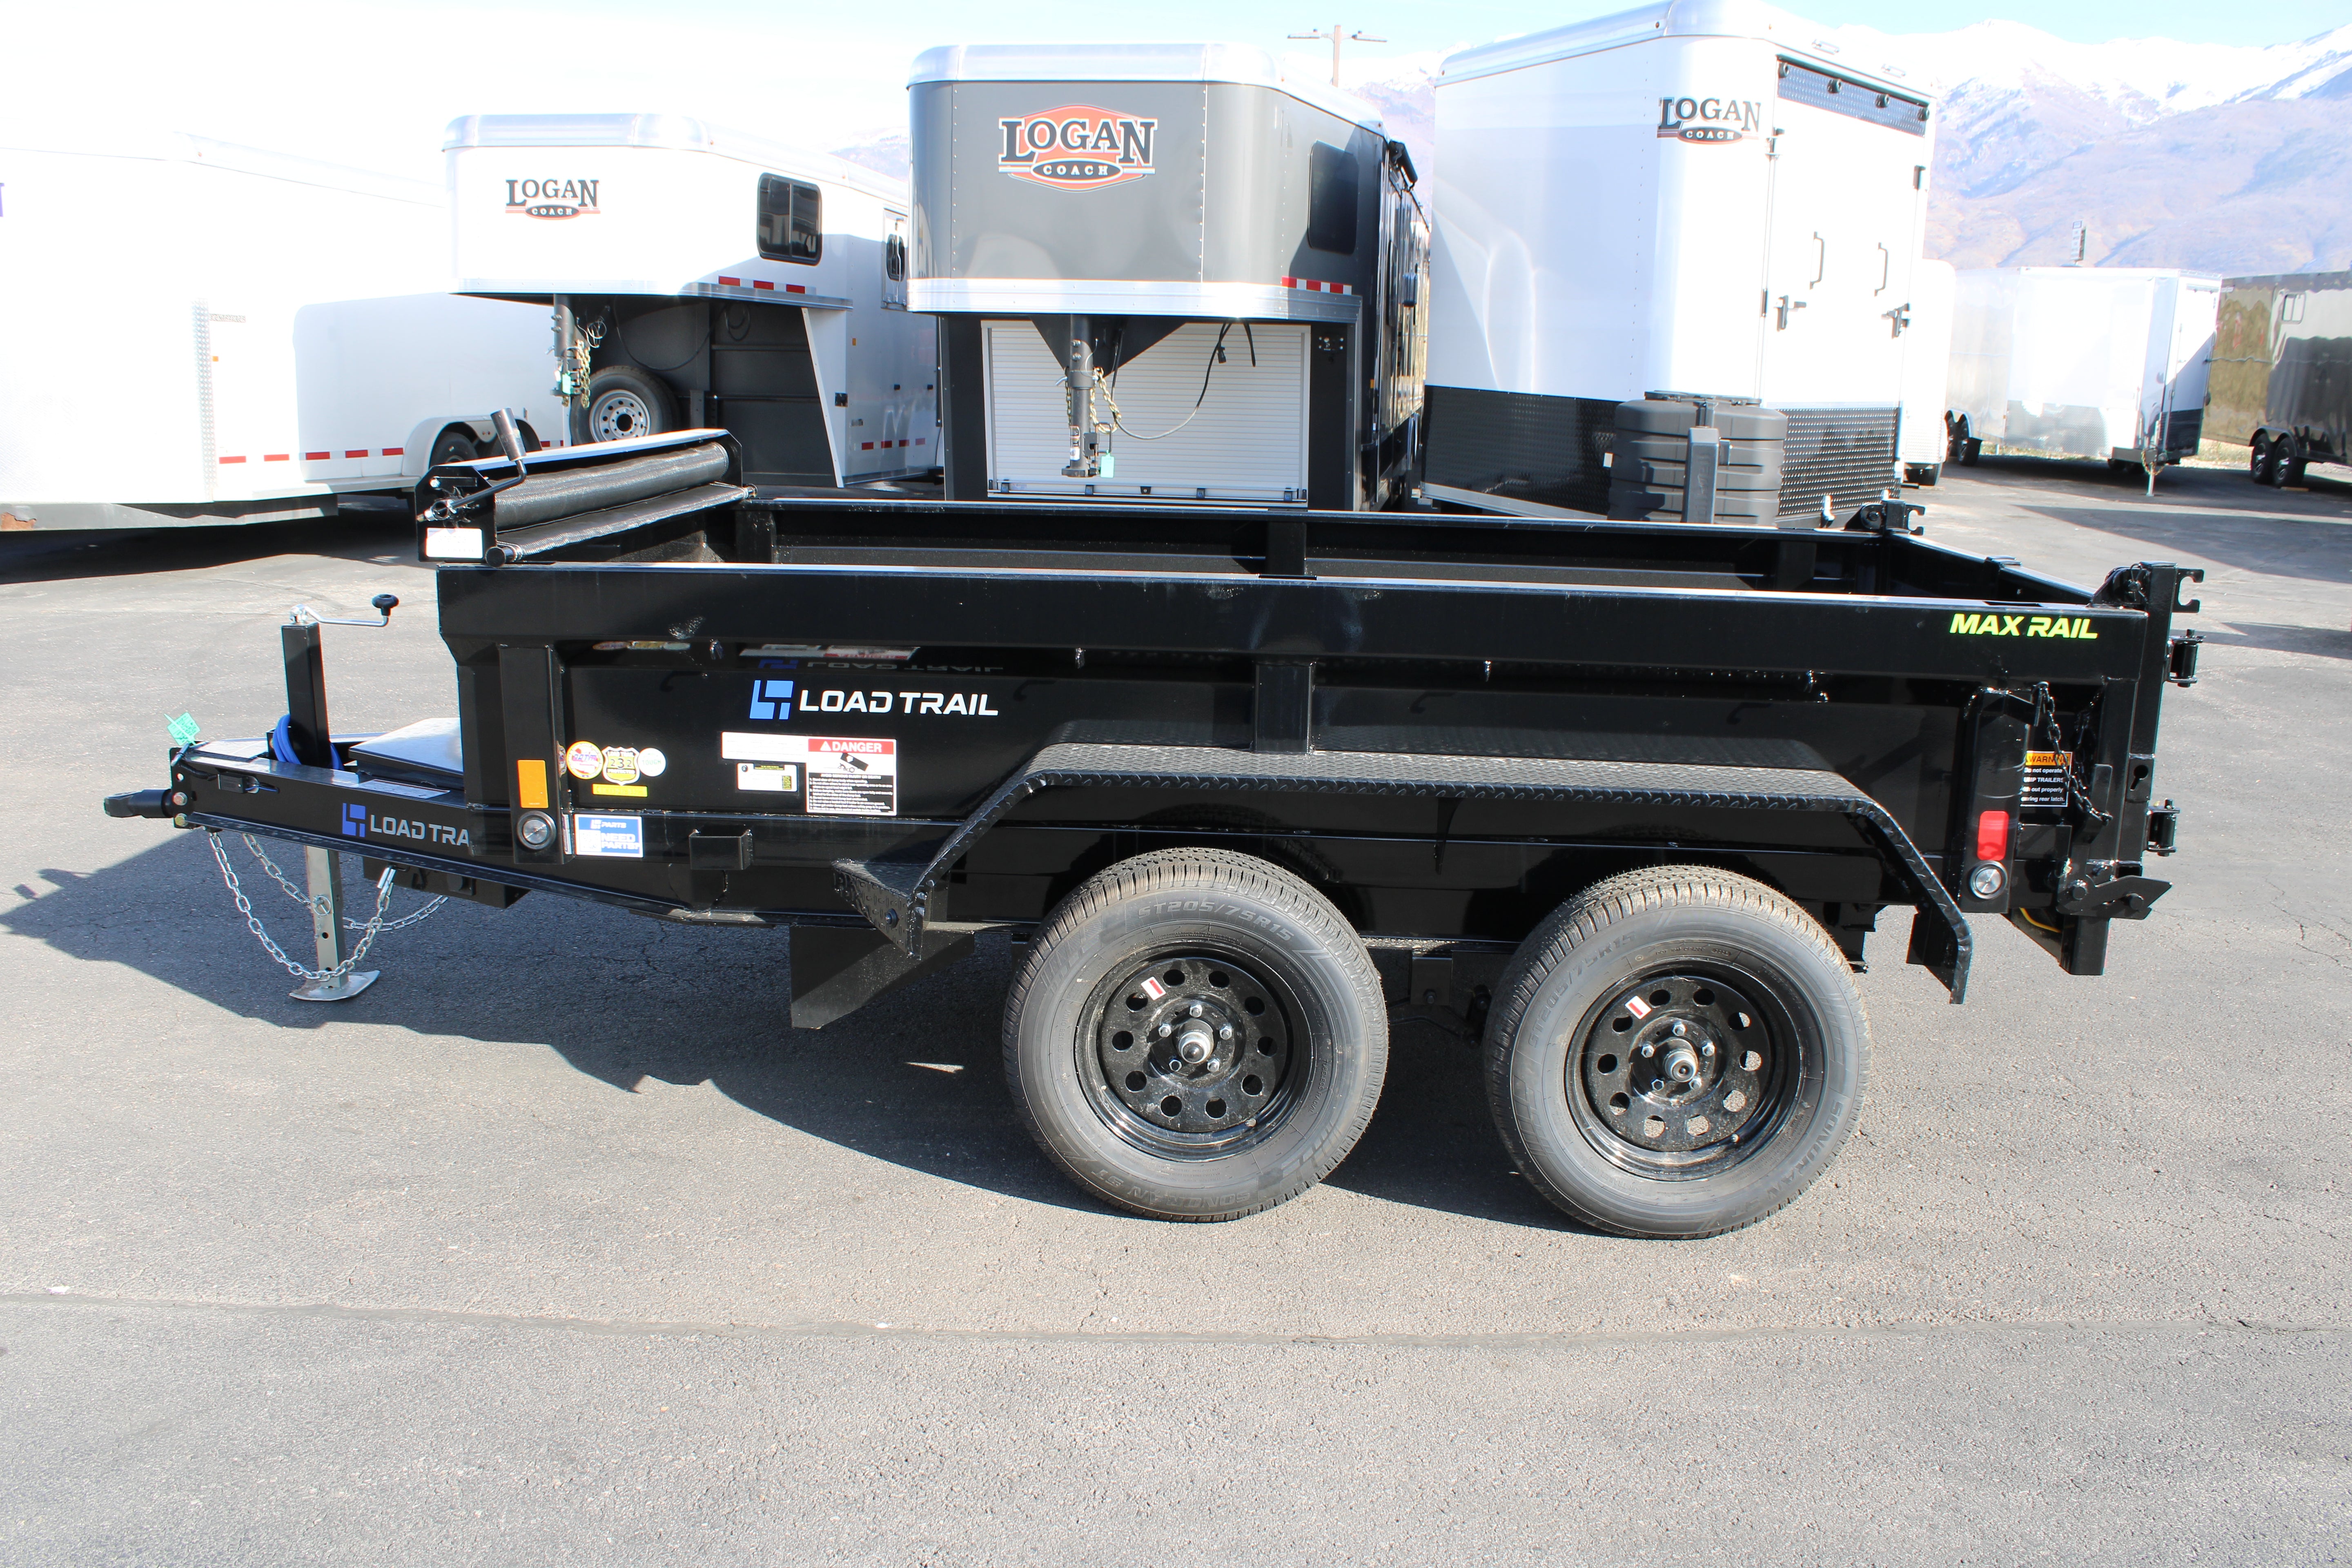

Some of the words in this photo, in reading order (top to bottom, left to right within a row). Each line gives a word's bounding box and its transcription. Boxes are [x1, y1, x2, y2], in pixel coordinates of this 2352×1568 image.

[1658, 97, 1761, 132] LOGAN
[1000, 118, 1157, 167] LOGAN
[1685, 131, 1735, 140] COACH
[1043, 165, 1108, 176] COACH
[506, 179, 599, 207] LOGAN
[1949, 613, 2025, 636] MAX
[2027, 616, 2098, 639] RAIL
[799, 690, 893, 713] LOAD
[899, 692, 999, 716] TRAIL
[832, 741, 882, 753] DANGER
[370, 814, 425, 840] LOAD
[601, 833, 635, 842] NEED
[1138, 901, 1294, 942] ST205/75R15
[1129, 1186, 1250, 1207] SONORAN
